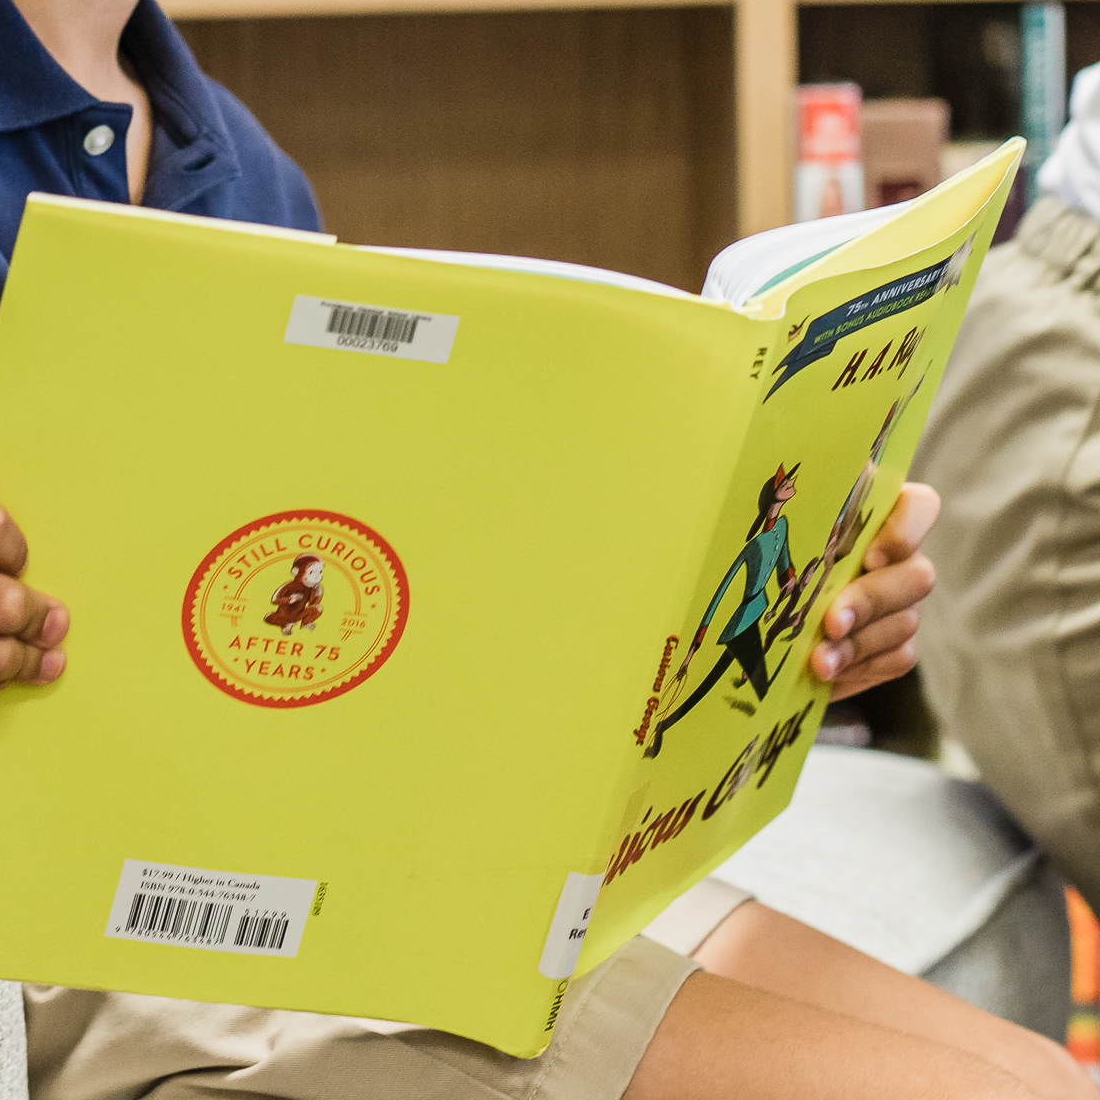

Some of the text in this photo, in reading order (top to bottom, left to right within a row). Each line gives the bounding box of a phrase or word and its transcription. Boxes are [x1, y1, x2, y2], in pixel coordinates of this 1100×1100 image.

[813, 328, 835, 345] WITH
[835, 313, 865, 334] BONUS
[865, 294, 914, 321] AUDIOBOOK
[750, 346, 768, 380] REY
[831, 347, 870, 392] H.
[859, 337, 895, 383] A.
[227, 533, 381, 597] STILL CURIOUS
[220, 601, 247, 614] 1941
[340, 617, 367, 629] 2016
[228, 635, 341, 662] AFTER 75
[244, 657, 315, 681] YEARS
[140, 880, 167, 892] ISBN
[142, 867, 174, 881] $17.99
[182, 873, 214, 886] Higher
[215, 879, 226, 887] in
[227, 879, 261, 891] Canada
[582, 907, 592, 920] E
